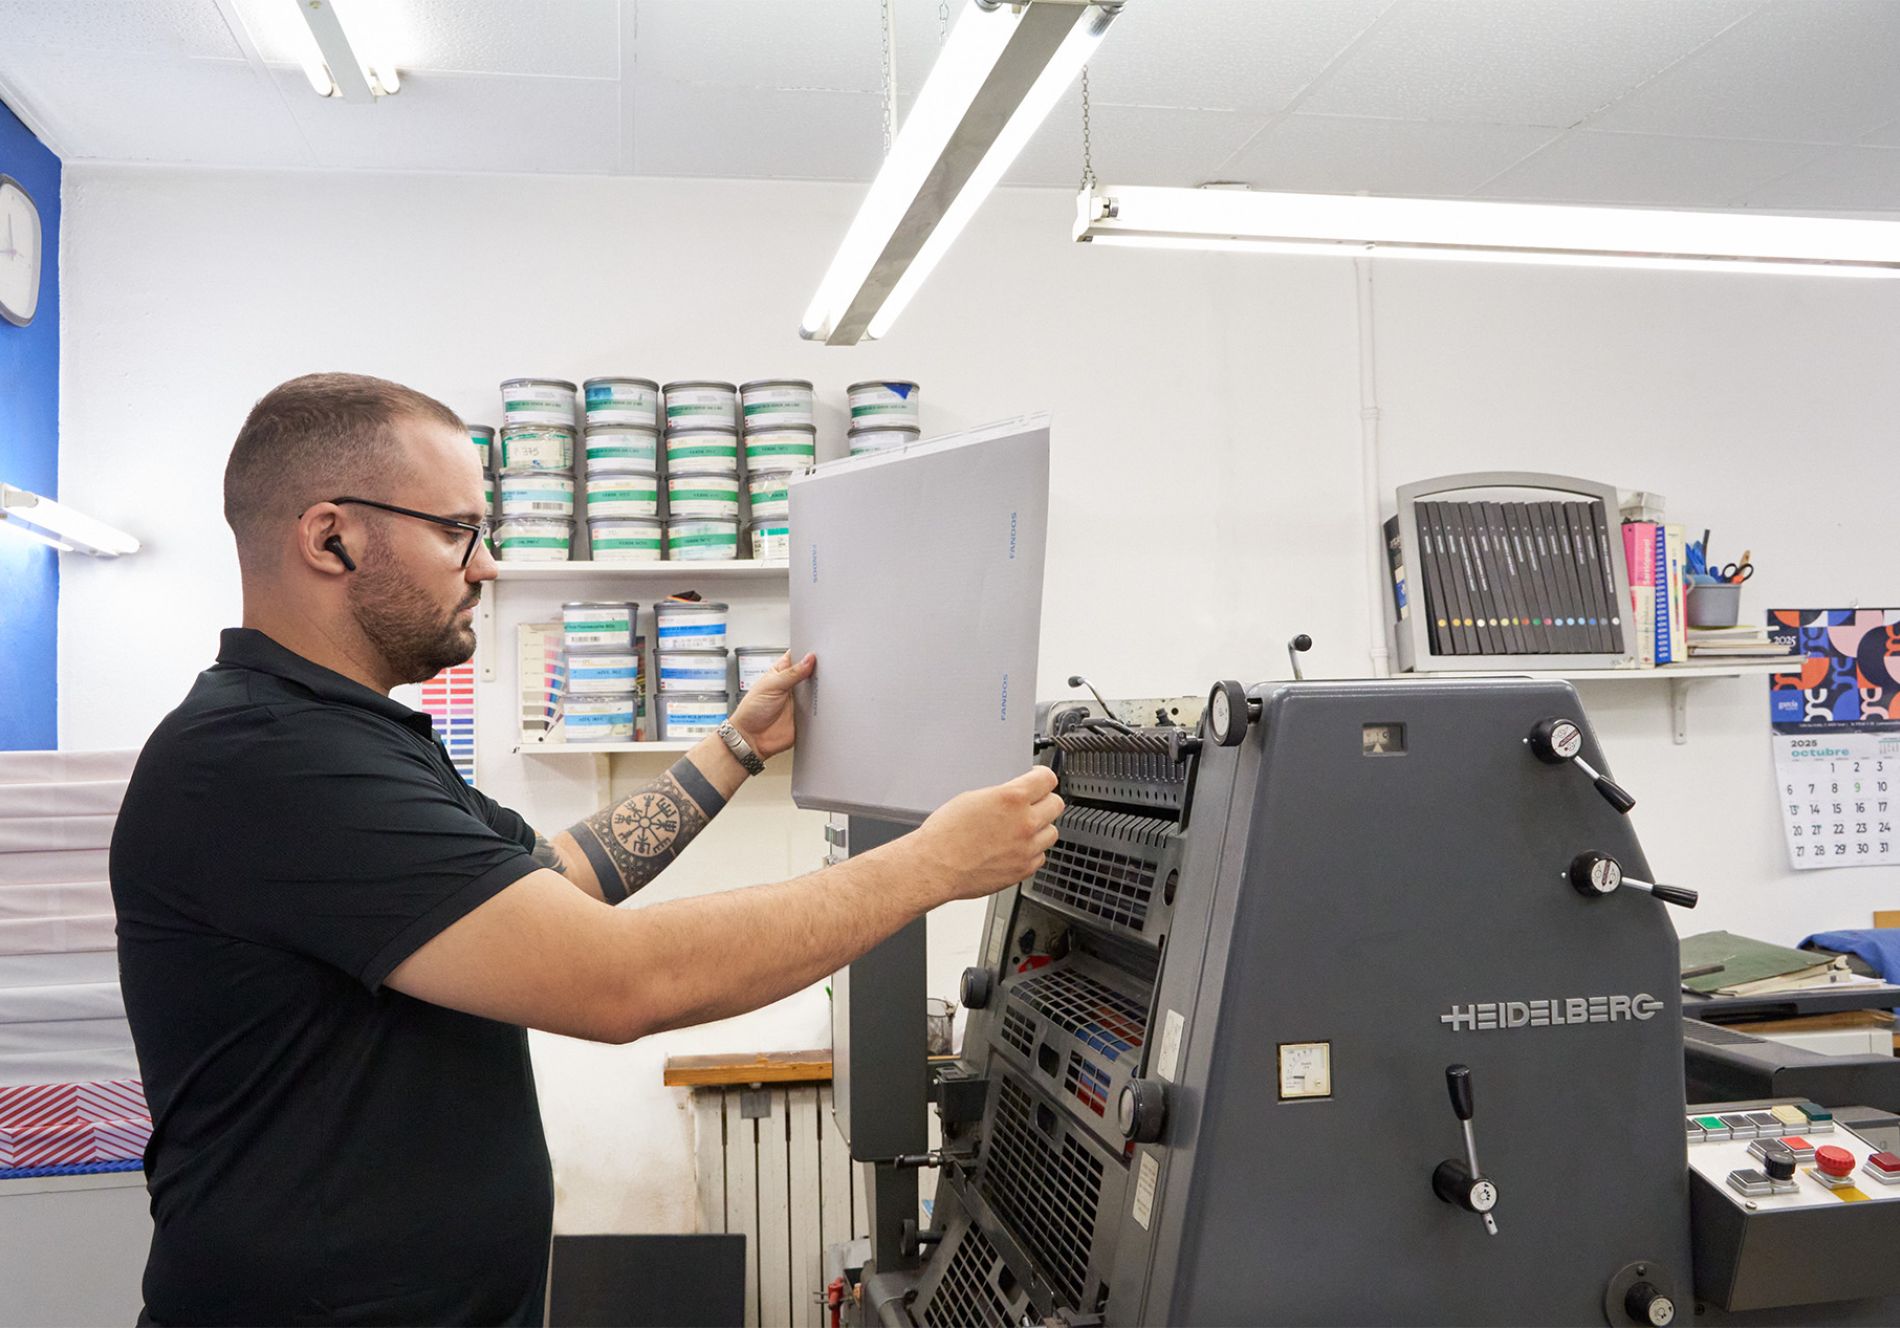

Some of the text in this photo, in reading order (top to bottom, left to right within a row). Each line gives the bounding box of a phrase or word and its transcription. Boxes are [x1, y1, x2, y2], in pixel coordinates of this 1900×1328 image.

[1008, 512, 1017, 559] FANDOS
[1774, 636, 1797, 647] 2025
[1000, 674, 1009, 721] FANDOS
[1791, 748, 1850, 757] octubre
[1831, 762, 1883, 772] 1 2 3
[1787, 782, 1887, 795] 6 7 8 9 10
[1790, 802, 1887, 815] 13 14 15 16 17
[1793, 822, 1891, 836] 20 21 22 23 24
[1796, 842, 1888, 856] 27 28 29 30 31
[1440, 993, 1664, 1032] HEIDELBERG
